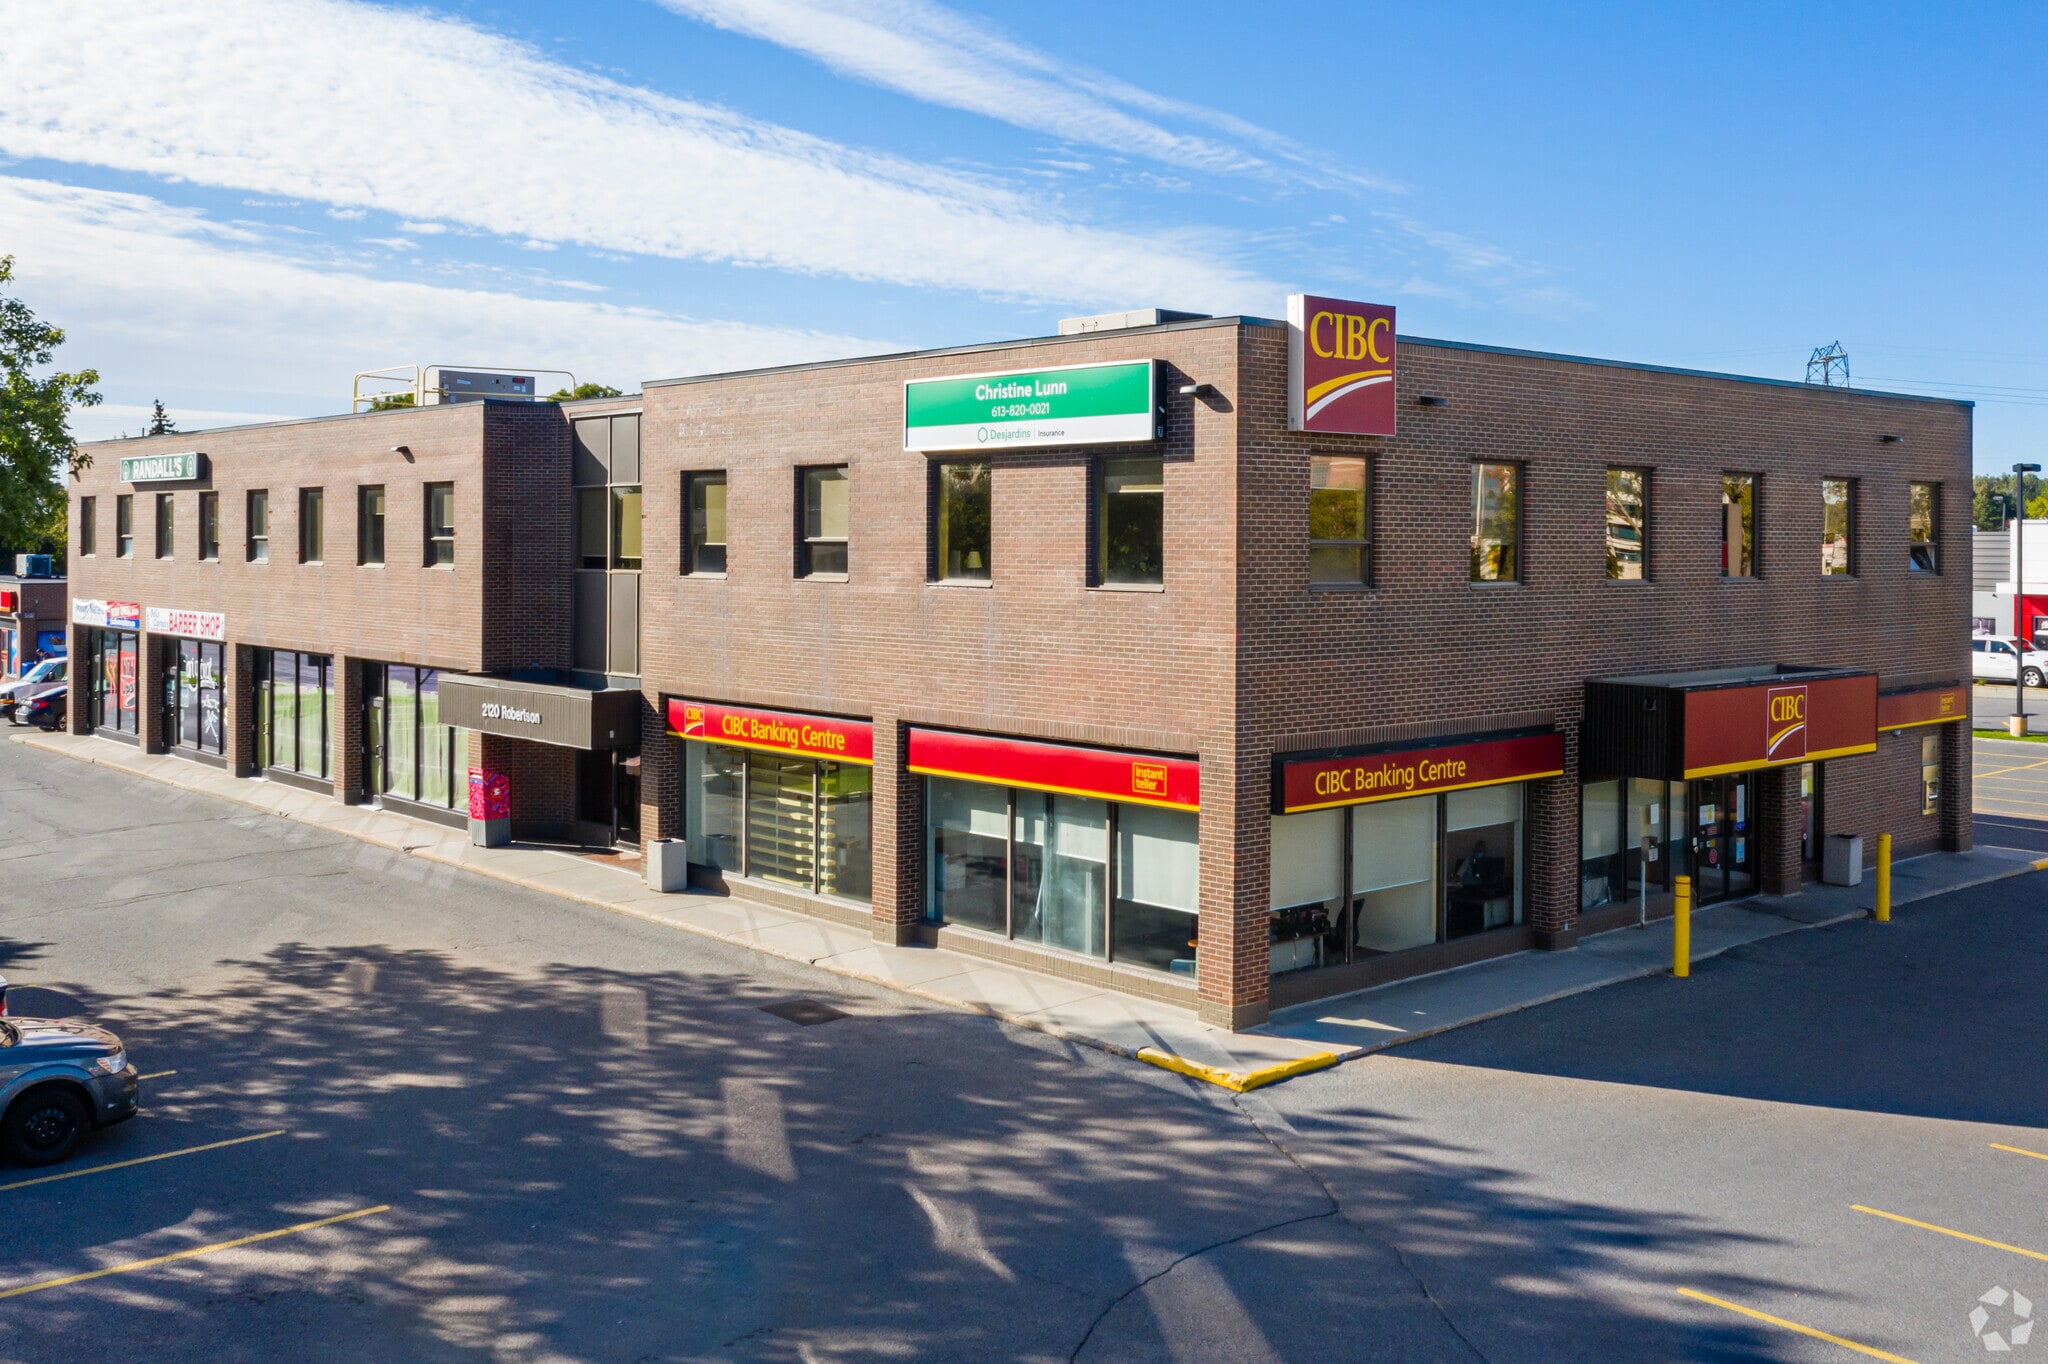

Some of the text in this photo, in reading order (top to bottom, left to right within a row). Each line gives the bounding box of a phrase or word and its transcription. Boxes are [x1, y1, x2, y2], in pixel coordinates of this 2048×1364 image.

[1310, 311, 1390, 363] CIBC
[975, 380, 1067, 401] Christine Lunn
[991, 402, 1050, 418] 613-820-0021
[990, 428, 1065, 441] Desjardins Insurance
[132, 457, 183, 480] RANDALL'S
[169, 612, 221, 638] BARBER SHOP
[482, 703, 541, 724] 2120 Robertson
[685, 707, 703, 721] CIBC
[1771, 694, 1805, 722] CIBC
[722, 715, 845, 750] CIBC Banking Centre
[1135, 766, 1164, 781] Instant
[1315, 758, 1466, 796] CIBC Banking Centre
[1136, 778, 1157, 791] teller
